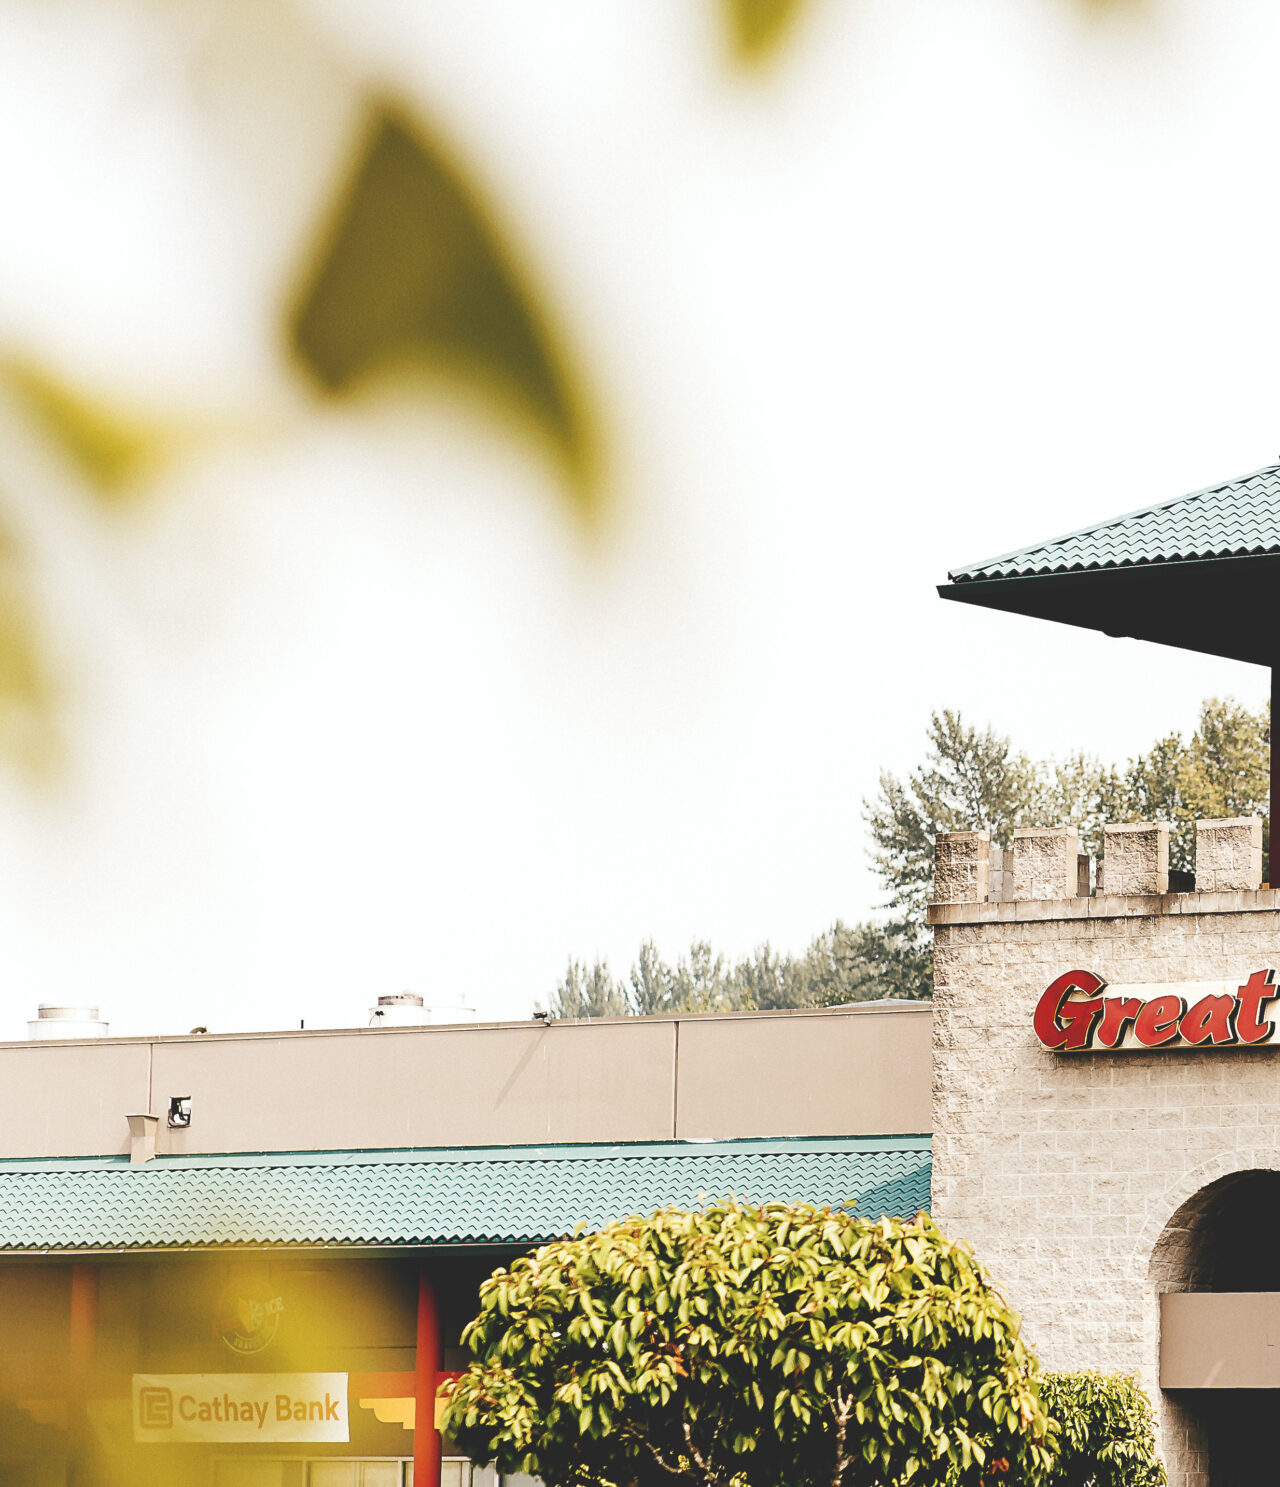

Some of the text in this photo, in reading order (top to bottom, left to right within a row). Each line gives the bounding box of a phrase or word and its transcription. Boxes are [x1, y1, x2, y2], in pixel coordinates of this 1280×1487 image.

[1033, 968, 1280, 1050] Great
[178, 1392, 340, 1430] Cathay Bank
